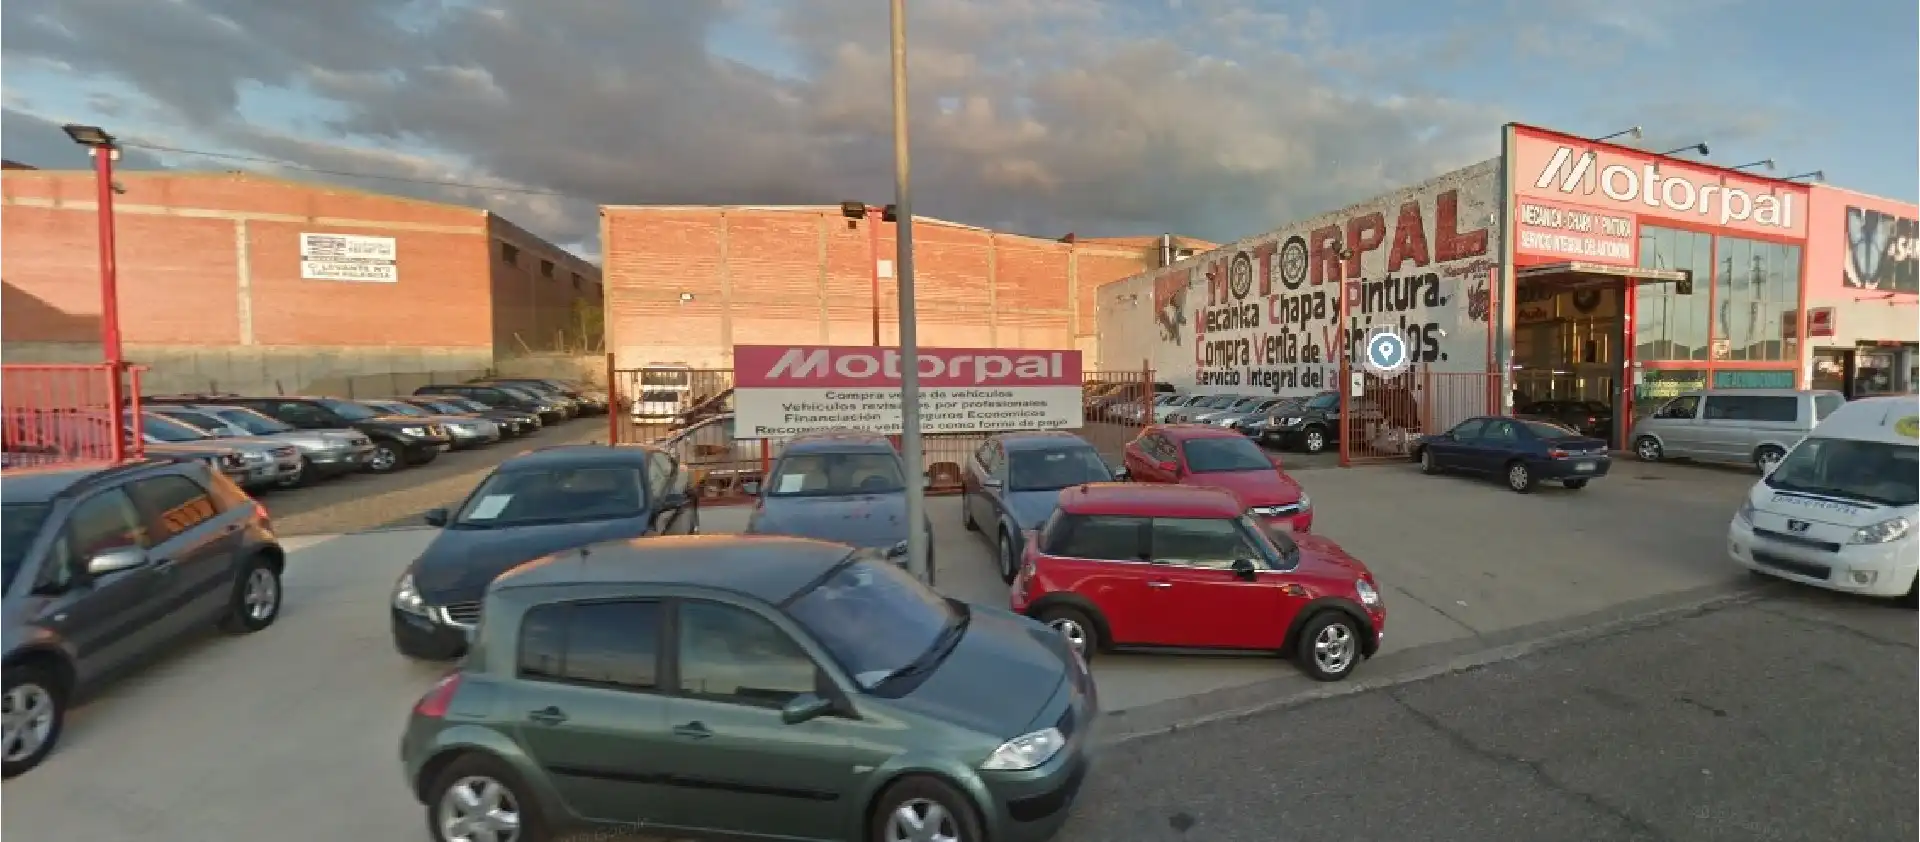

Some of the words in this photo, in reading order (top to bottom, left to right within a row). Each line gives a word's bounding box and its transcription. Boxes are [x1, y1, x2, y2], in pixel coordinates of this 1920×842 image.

[1534, 146, 1792, 228] Motorpal
[1205, 189, 1489, 306] MOTORPAL
[1269, 290, 1326, 332] Chapa
[1344, 272, 1446, 317] Pintura.
[1195, 334, 1250, 368] Compra
[1253, 325, 1297, 366] Venta
[1301, 341, 1320, 363] de
[1323, 316, 1448, 364] Vehos.
[764, 348, 1063, 384] Motorpal
[1195, 368, 1241, 386] Servicio
[1246, 367, 1297, 394] Integral
[1301, 367, 1320, 387] del
[825, 391, 885, 401] Compra
[889, 391, 927, 401] vea
[930, 389, 947, 398] de
[862, 402, 930, 411] revisas
[935, 401, 958, 410] por
[961, 399, 1048, 409] profesionales
[873, 420, 934, 431] vehlo
[937, 422, 975, 430] como
[978, 419, 1015, 429] forma
[1019, 419, 1034, 427] de
[918, 411, 963, 421] eguros
